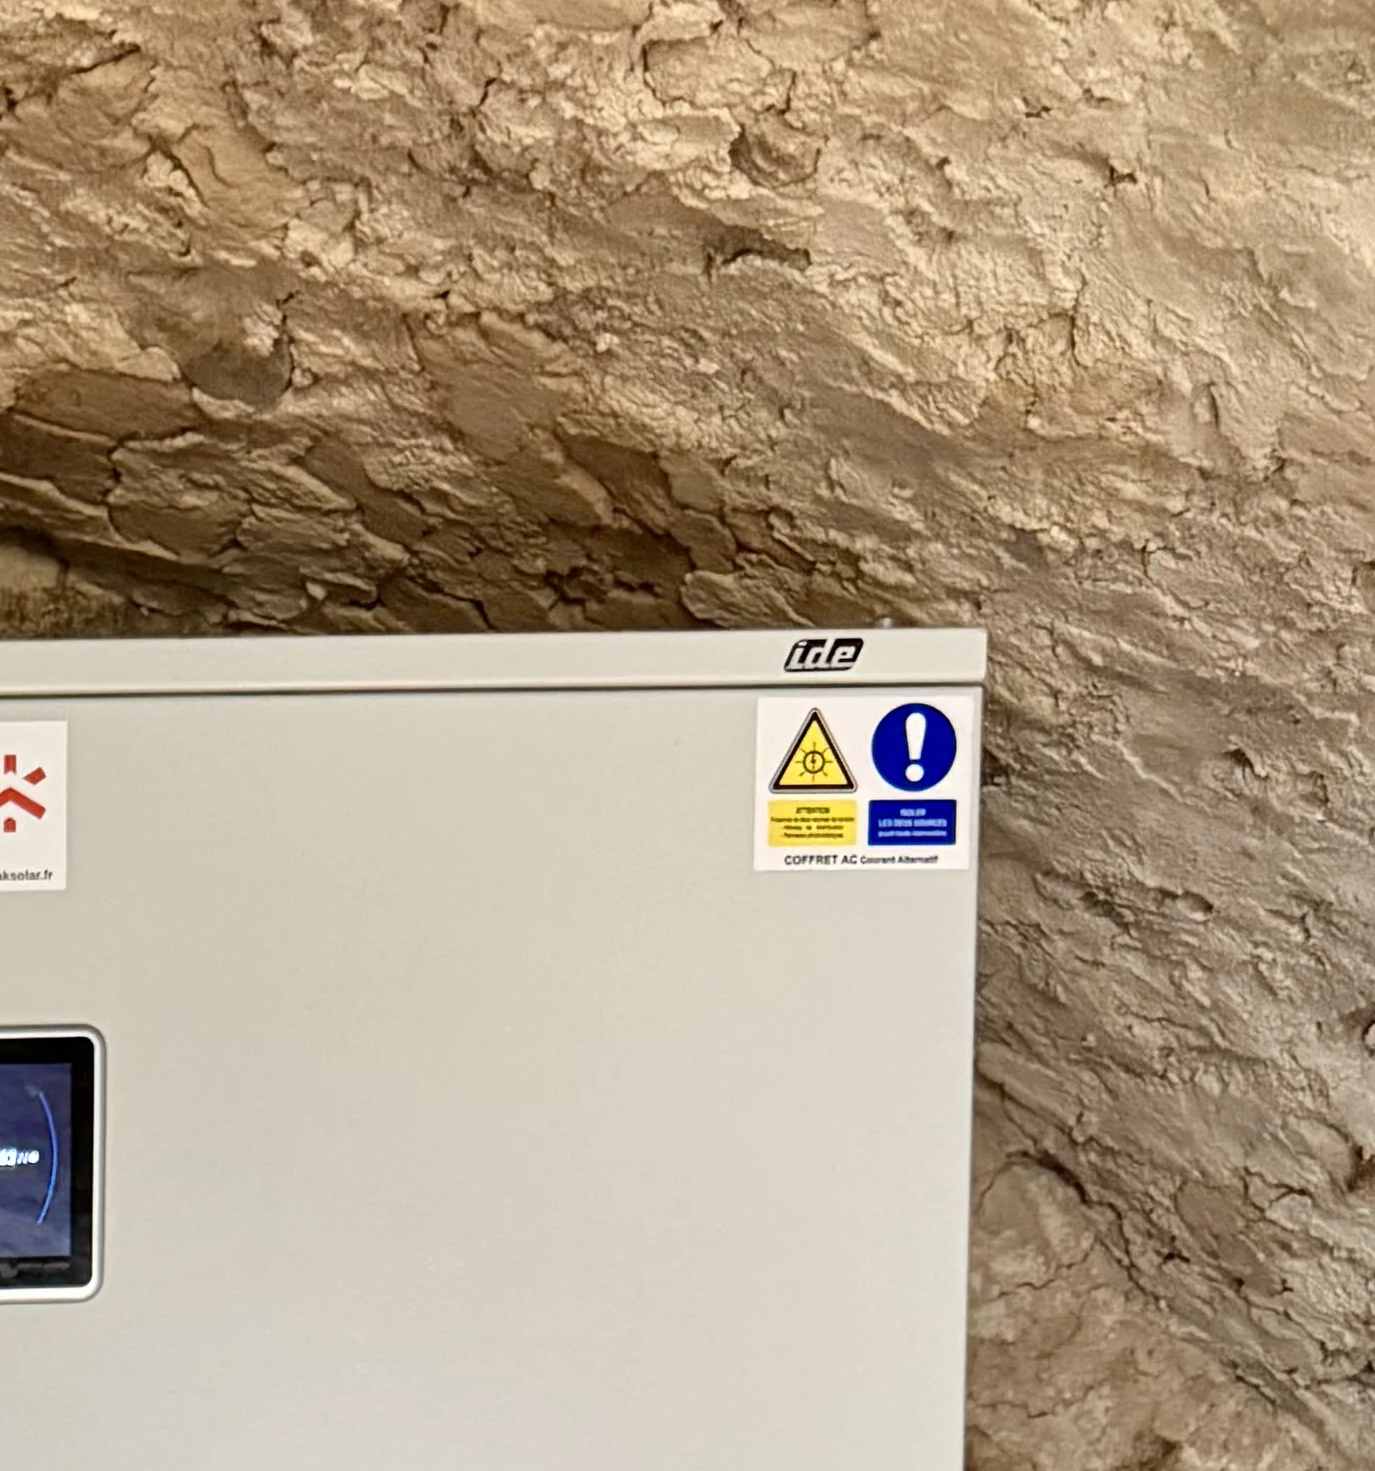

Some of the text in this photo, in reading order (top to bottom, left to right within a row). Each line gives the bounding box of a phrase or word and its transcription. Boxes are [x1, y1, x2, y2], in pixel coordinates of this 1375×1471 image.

[783, 637, 864, 672] ide
[784, 855, 838, 866] COFFRET
[840, 854, 858, 865] AC
